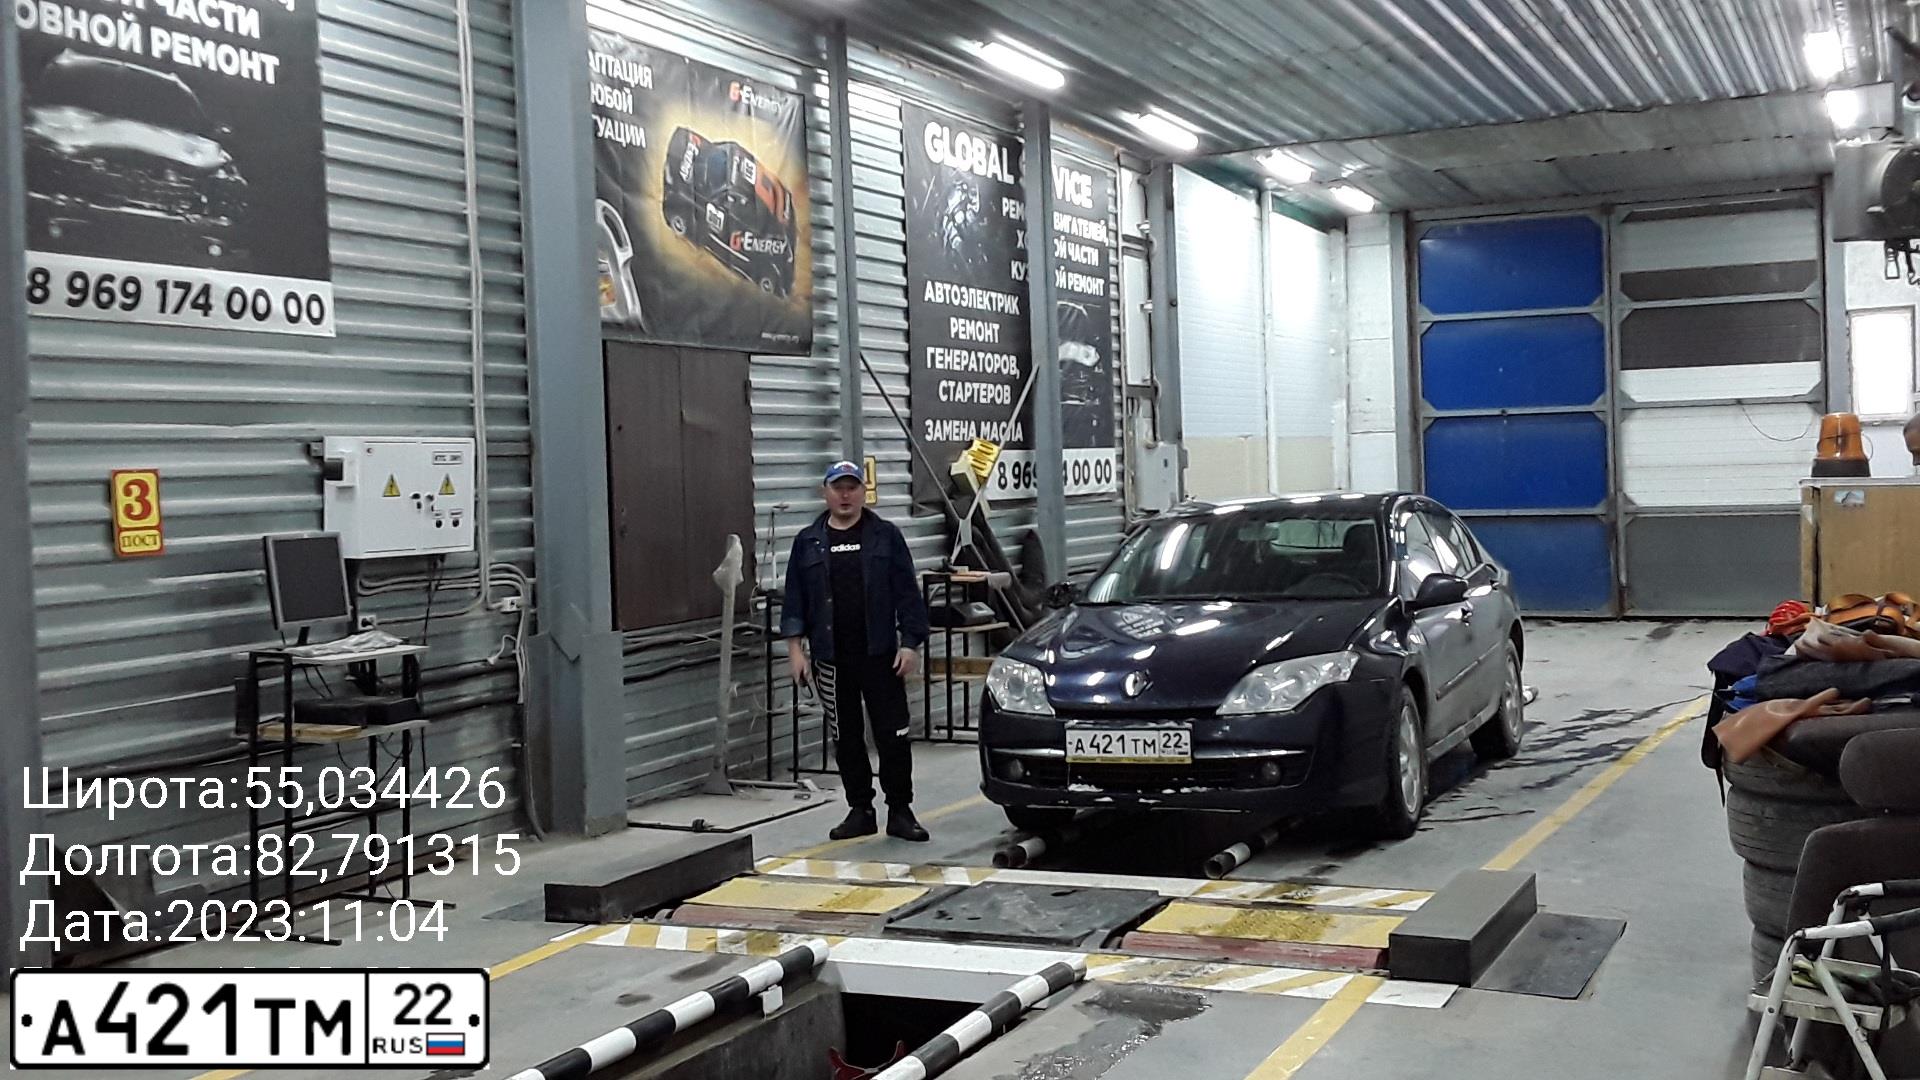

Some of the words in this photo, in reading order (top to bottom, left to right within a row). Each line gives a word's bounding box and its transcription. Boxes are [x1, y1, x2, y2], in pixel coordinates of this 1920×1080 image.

[150, 26, 280, 84] РЕМОНТ
[924, 121, 1015, 184] GLOBAL
[1068, 242, 1099, 267] ЧАСТИ
[26, 267, 50, 304] 8
[66, 271, 141, 311] 969
[156, 279, 213, 317] 174
[226, 286, 272, 322] 00
[283, 291, 325, 325] 00
[924, 280, 1020, 315] АВТОЭЛЕКТРИК
[1068, 272, 1105, 296] РЕМОНТ
[950, 316, 1000, 343] РЕМОНТ
[926, 346, 1020, 379] ГЕНЕРАТОРОВ,
[938, 380, 1011, 405] СТАРТЕРОВ
[925, 419, 977, 442] ЗАМЕНА
[998, 461, 1008, 490] 8
[1072, 459, 1091, 485] 00
[1094, 458, 1112, 485] 00
[123, 479, 152, 521] 3
[121, 534, 158, 548] ПОСТ
[830, 543, 861, 553] adidas
[1162, 733, 1183, 748] 22
